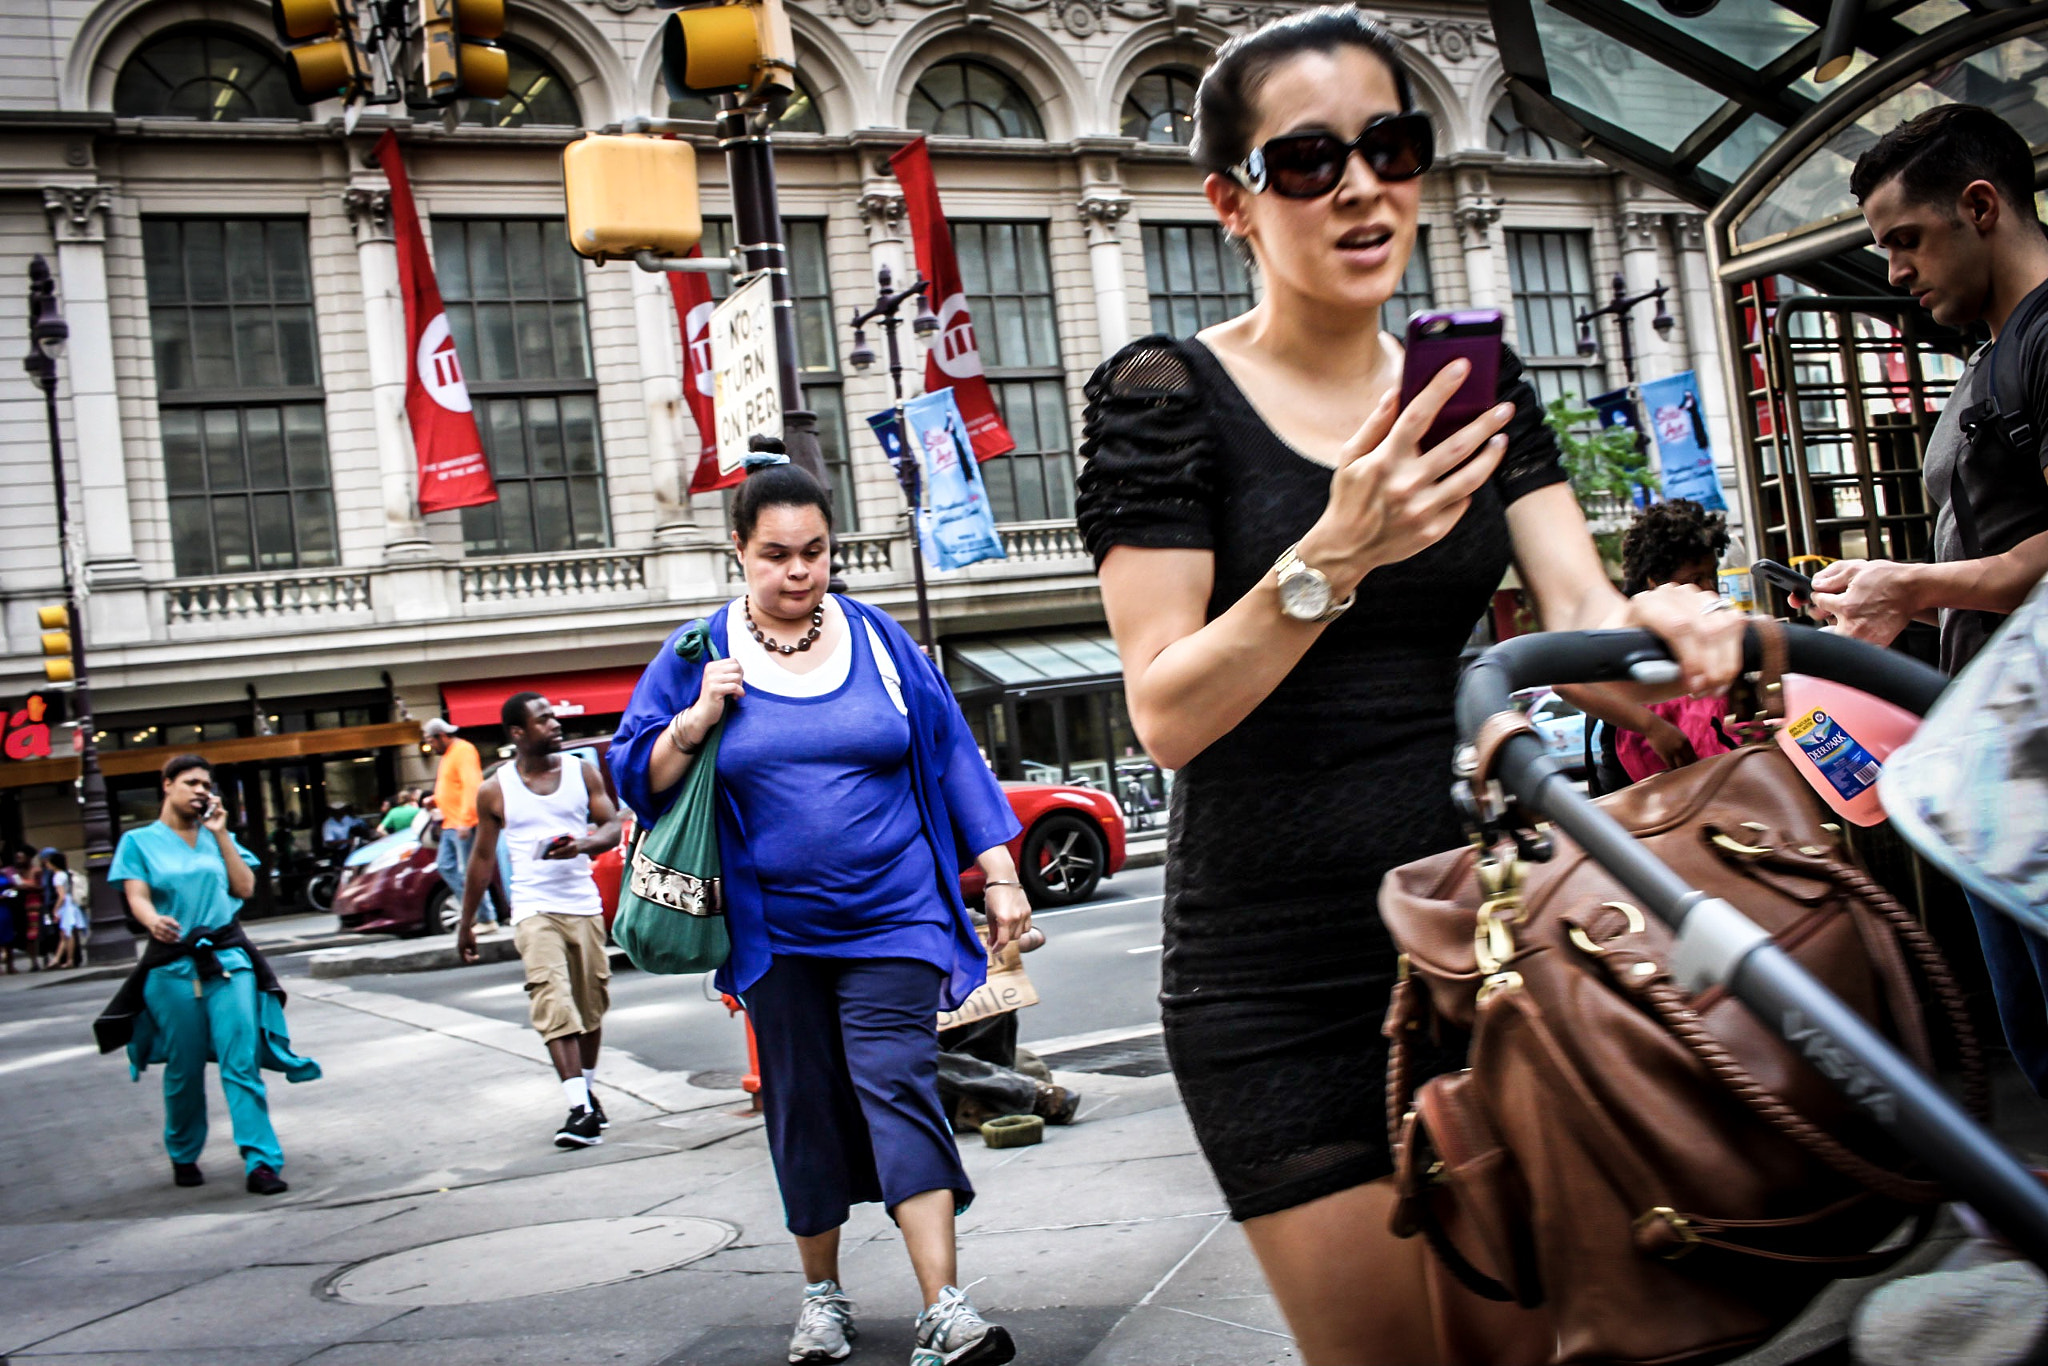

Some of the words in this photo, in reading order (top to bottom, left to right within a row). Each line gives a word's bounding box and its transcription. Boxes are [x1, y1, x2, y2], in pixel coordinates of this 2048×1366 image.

[730, 309, 750, 349] NO
[724, 344, 765, 398] TURN
[723, 408, 742, 446] ON
[1807, 745, 1828, 761] DEER
[1825, 731, 1847, 750] PARK
